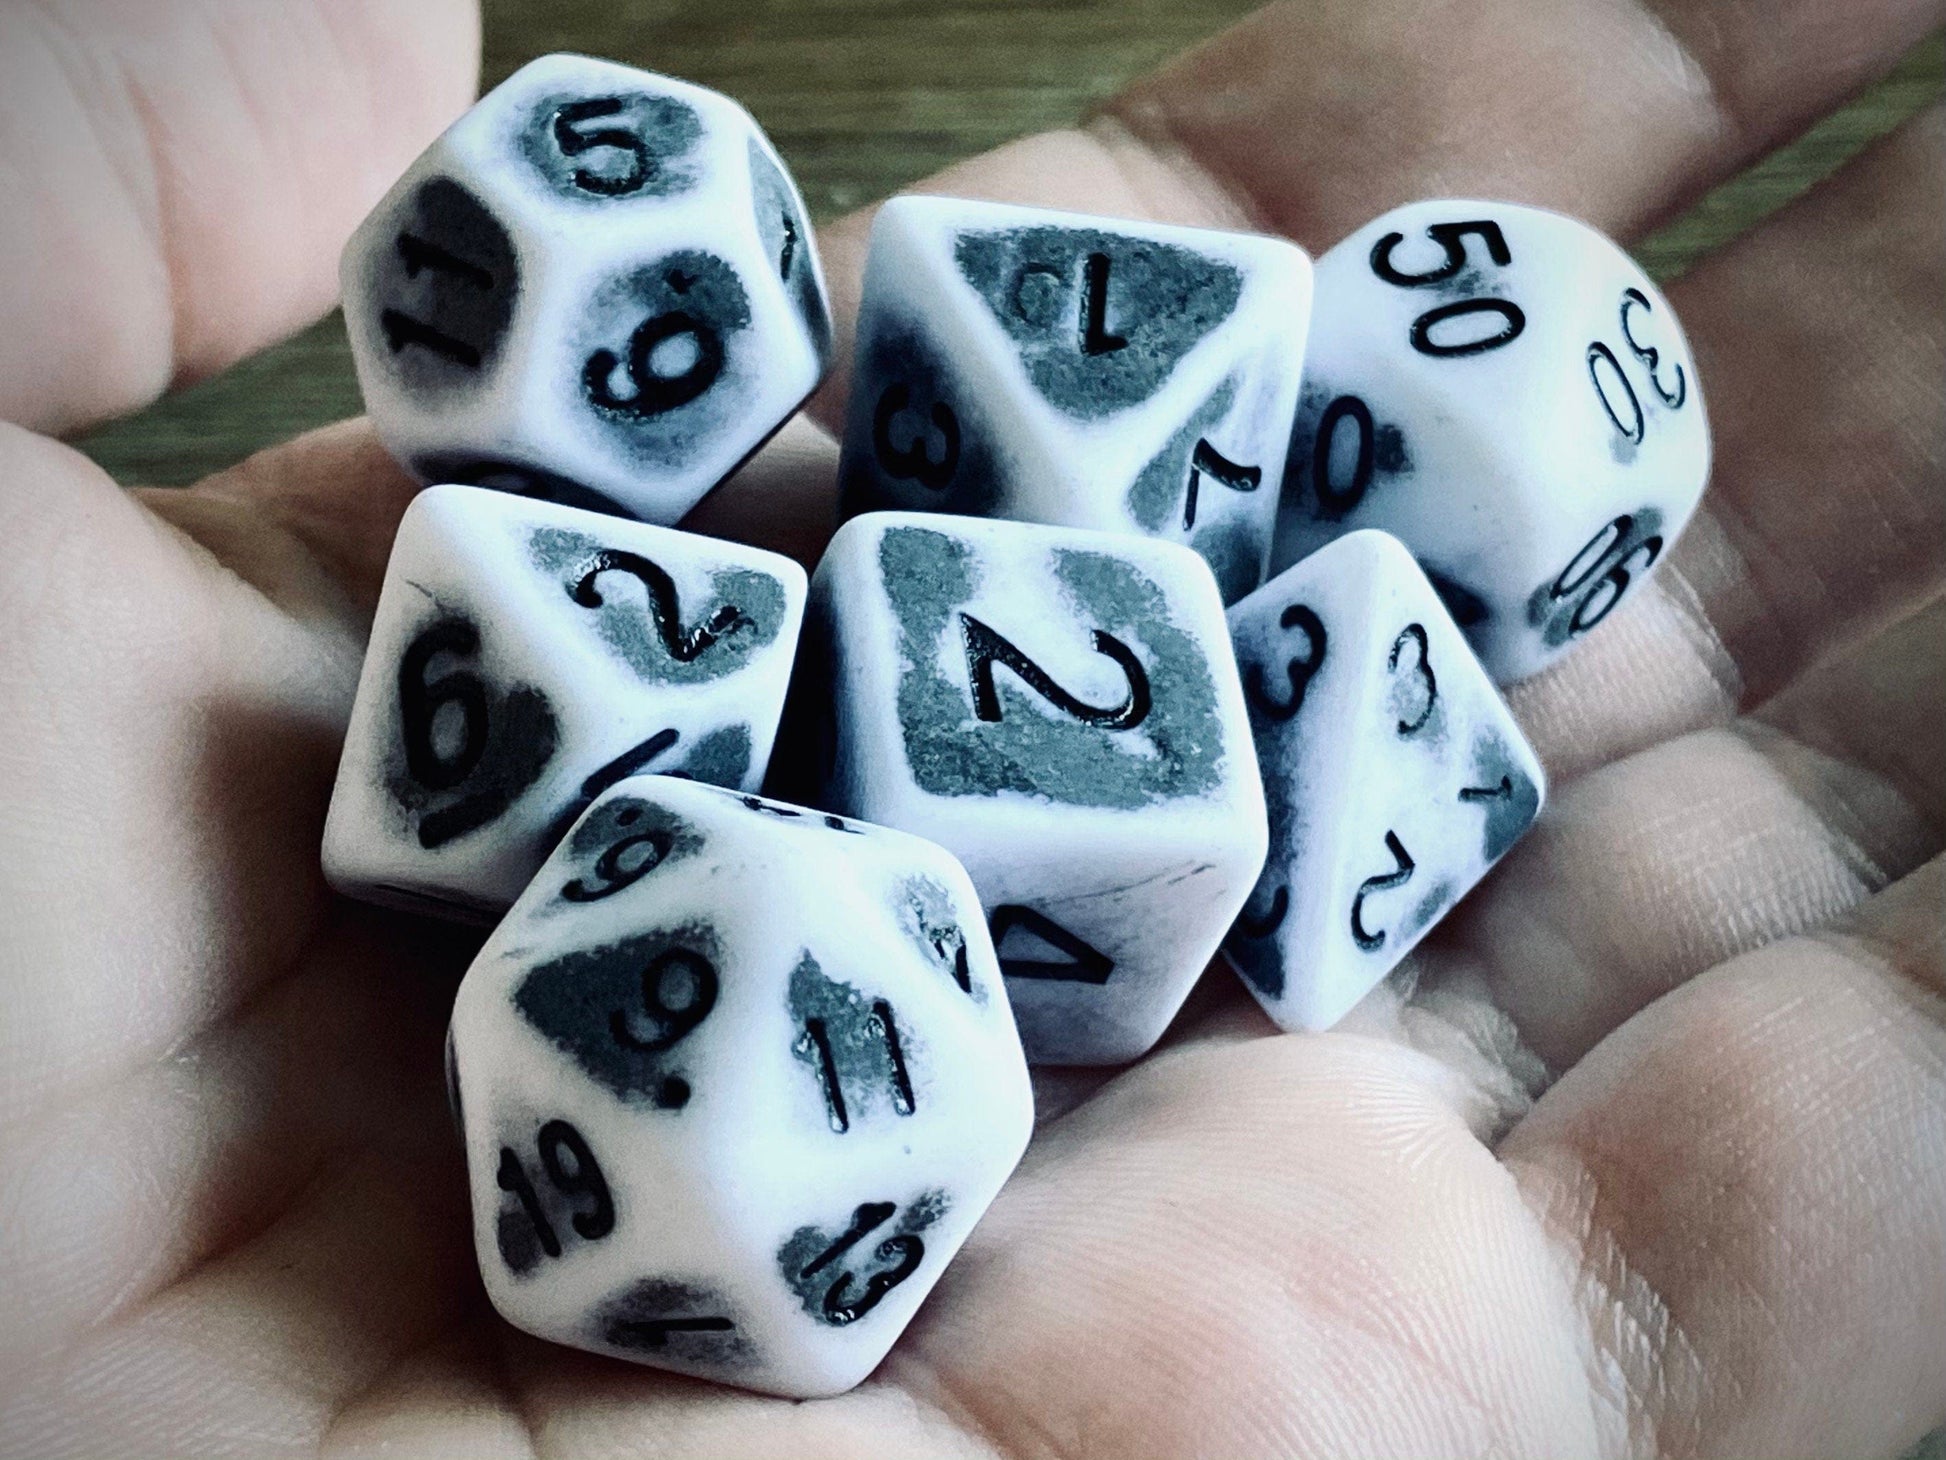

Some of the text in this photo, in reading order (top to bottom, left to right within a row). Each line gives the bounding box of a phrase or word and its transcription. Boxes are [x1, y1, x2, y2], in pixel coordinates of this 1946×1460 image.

[554, 96, 649, 196] 5
[381, 232, 494, 370] 11
[1369, 219, 1527, 358] 50
[1586, 287, 1687, 446] 30
[872, 382, 961, 491] 3
[566, 548, 758, 662] 2
[1248, 604, 1328, 722] 3
[960, 611, 1151, 731] 2
[1388, 622, 1437, 736] 3
[1458, 774, 1512, 802] 1
[1350, 829, 1416, 952] 2
[791, 997, 917, 1135] 11
[497, 1119, 616, 1259] 19
[800, 1201, 925, 1327] 13
